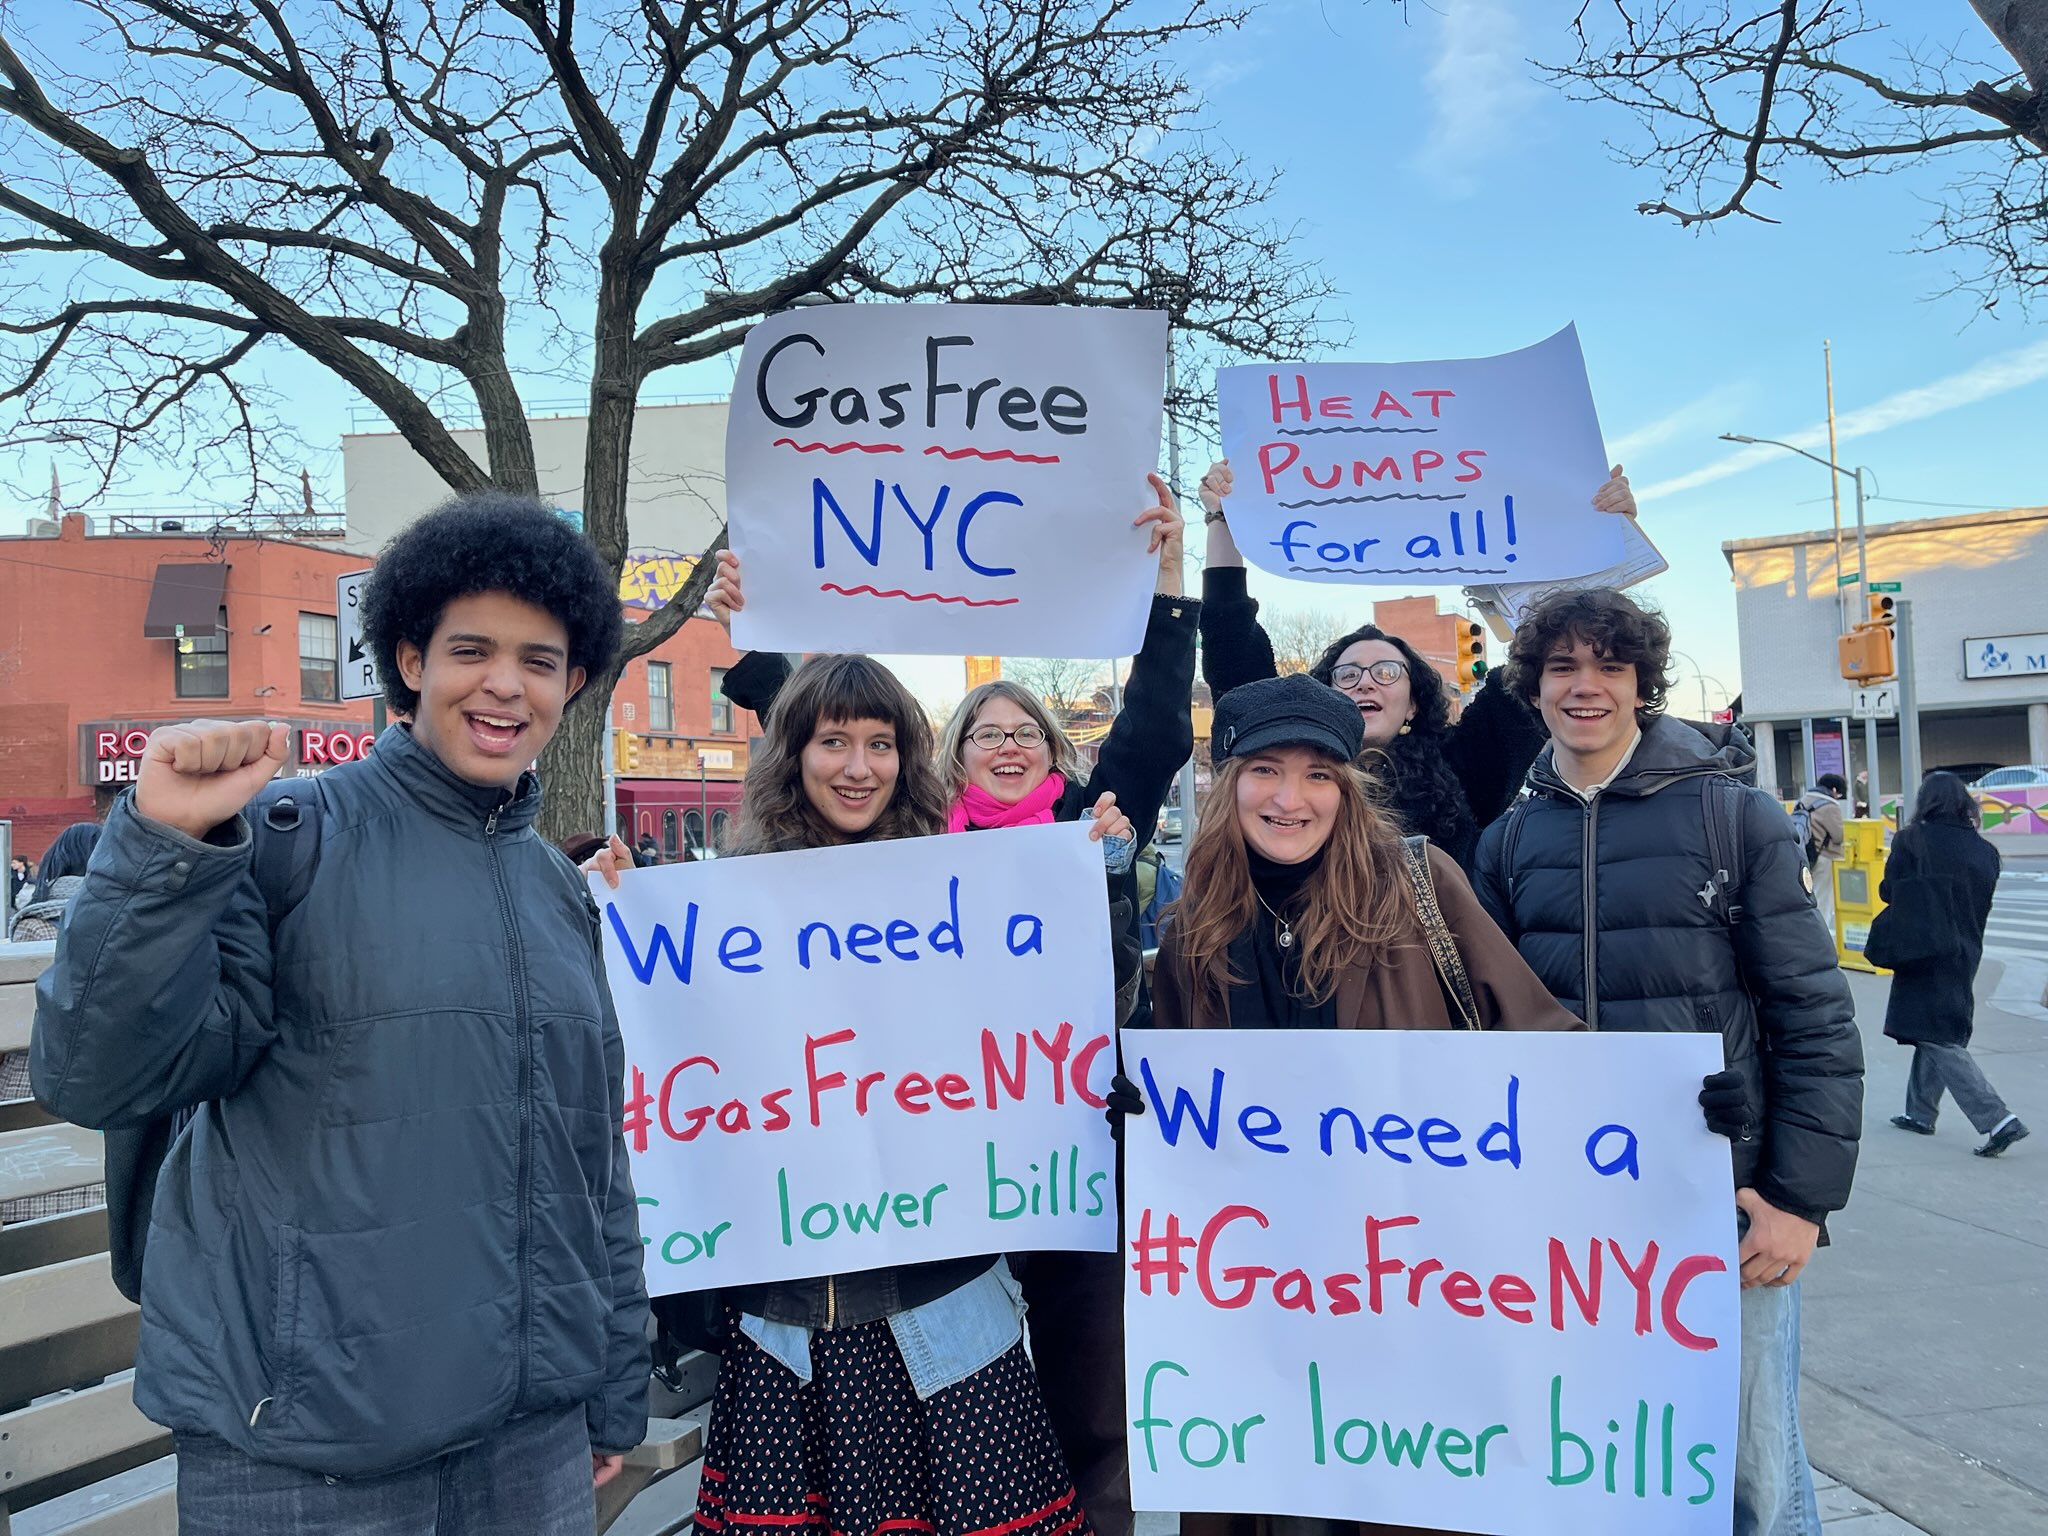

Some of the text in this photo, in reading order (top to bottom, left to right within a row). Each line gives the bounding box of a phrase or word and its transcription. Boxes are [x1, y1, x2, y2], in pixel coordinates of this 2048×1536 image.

[1268, 374, 1456, 423] HEAT
[1258, 442, 1488, 494] PUMPS
[813, 478, 1024, 577] NYC
[1270, 495, 1517, 563] for all!
[606, 876, 1043, 986] We need a
[623, 1021, 1111, 1153] #GasFreeNYC
[1140, 1058, 1640, 1180] We need a
[778, 1168, 949, 1246] lower
[986, 1141, 1107, 1220] bills
[1131, 1205, 1728, 1352] #GasFreeNYC
[1133, 1361, 1717, 1505] for lower bills
